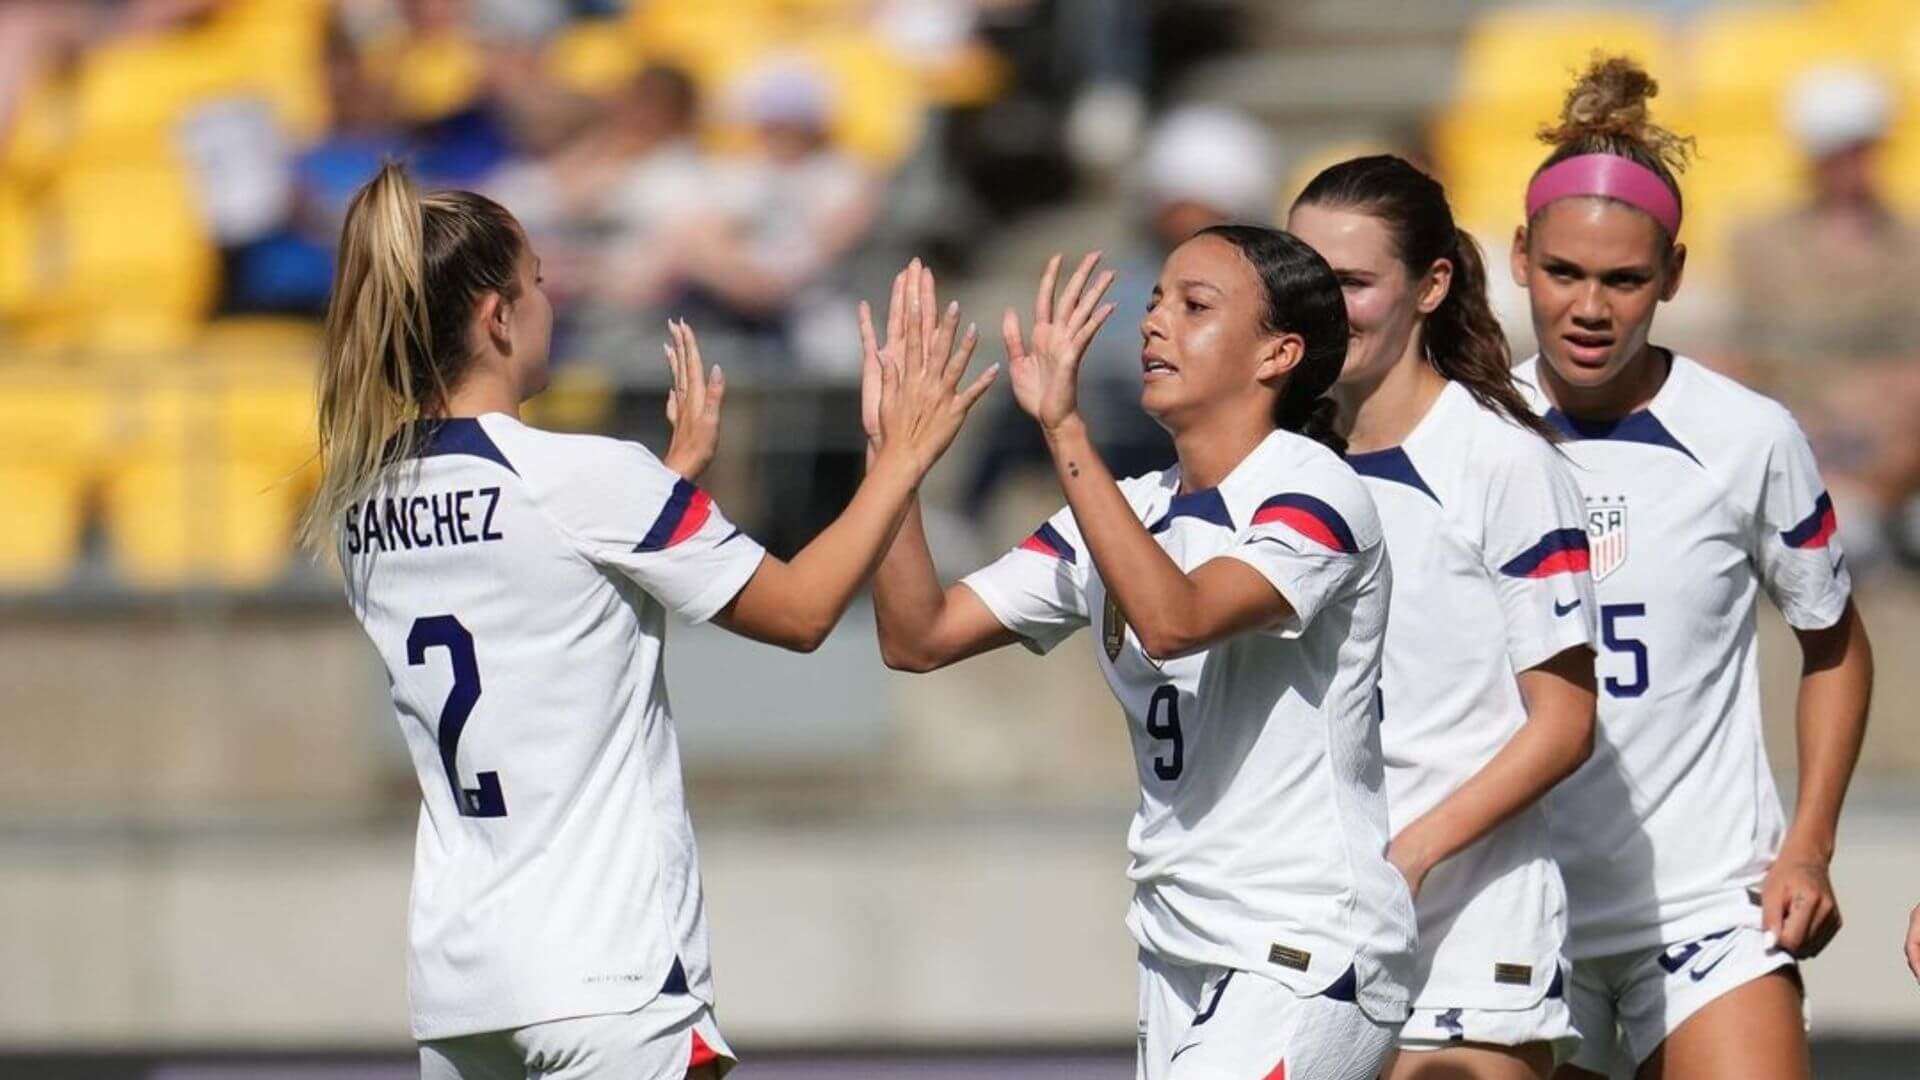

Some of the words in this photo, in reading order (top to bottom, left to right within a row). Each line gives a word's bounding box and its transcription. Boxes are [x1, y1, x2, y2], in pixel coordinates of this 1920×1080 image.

[346, 487, 503, 554] SANCHEZ
[1586, 511, 1621, 537] SA
[406, 614, 507, 817] 2
[1147, 684, 1183, 780] 9
